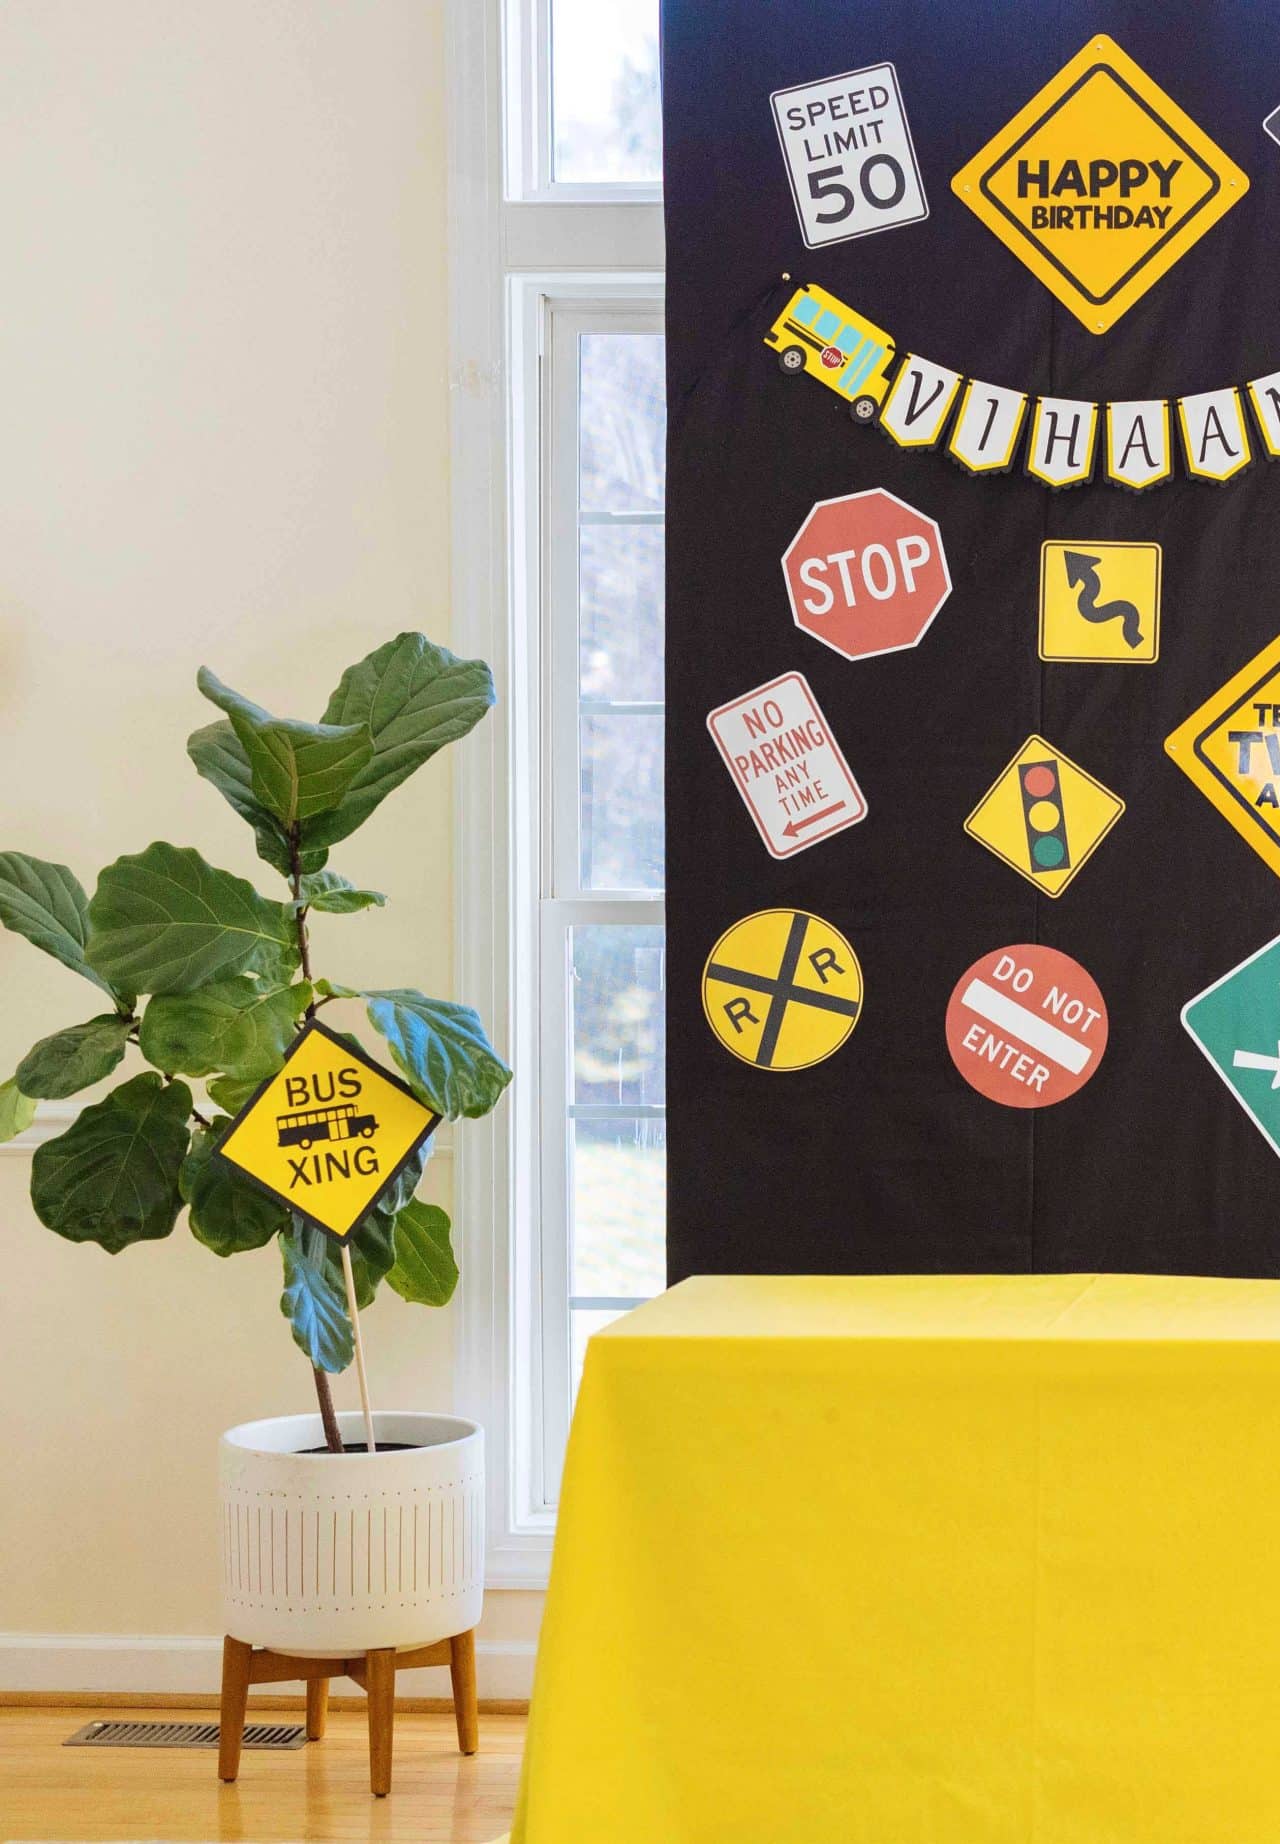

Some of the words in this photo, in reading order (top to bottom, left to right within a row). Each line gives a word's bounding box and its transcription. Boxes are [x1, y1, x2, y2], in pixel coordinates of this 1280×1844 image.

[786, 86, 889, 131] SPEED
[803, 120, 884, 162] LIMIT
[807, 153, 906, 224] 50
[1017, 159, 1184, 198] HAPPY
[1031, 205, 1173, 230] BIRTHDAY
[823, 350, 841, 365] STOP
[799, 535, 931, 615] STOP
[742, 700, 784, 739] NO
[734, 719, 825, 783] PARKING
[774, 760, 810, 794] ANY
[778, 780, 829, 816] TIME
[808, 947, 846, 984] R
[992, 954, 1034, 993] DO
[1042, 986, 1101, 1033] NOT
[723, 997, 760, 1034] R
[962, 1023, 1050, 1093] ENTER
[285, 1068, 362, 1107] BUS
[287, 1146, 379, 1189] XING
